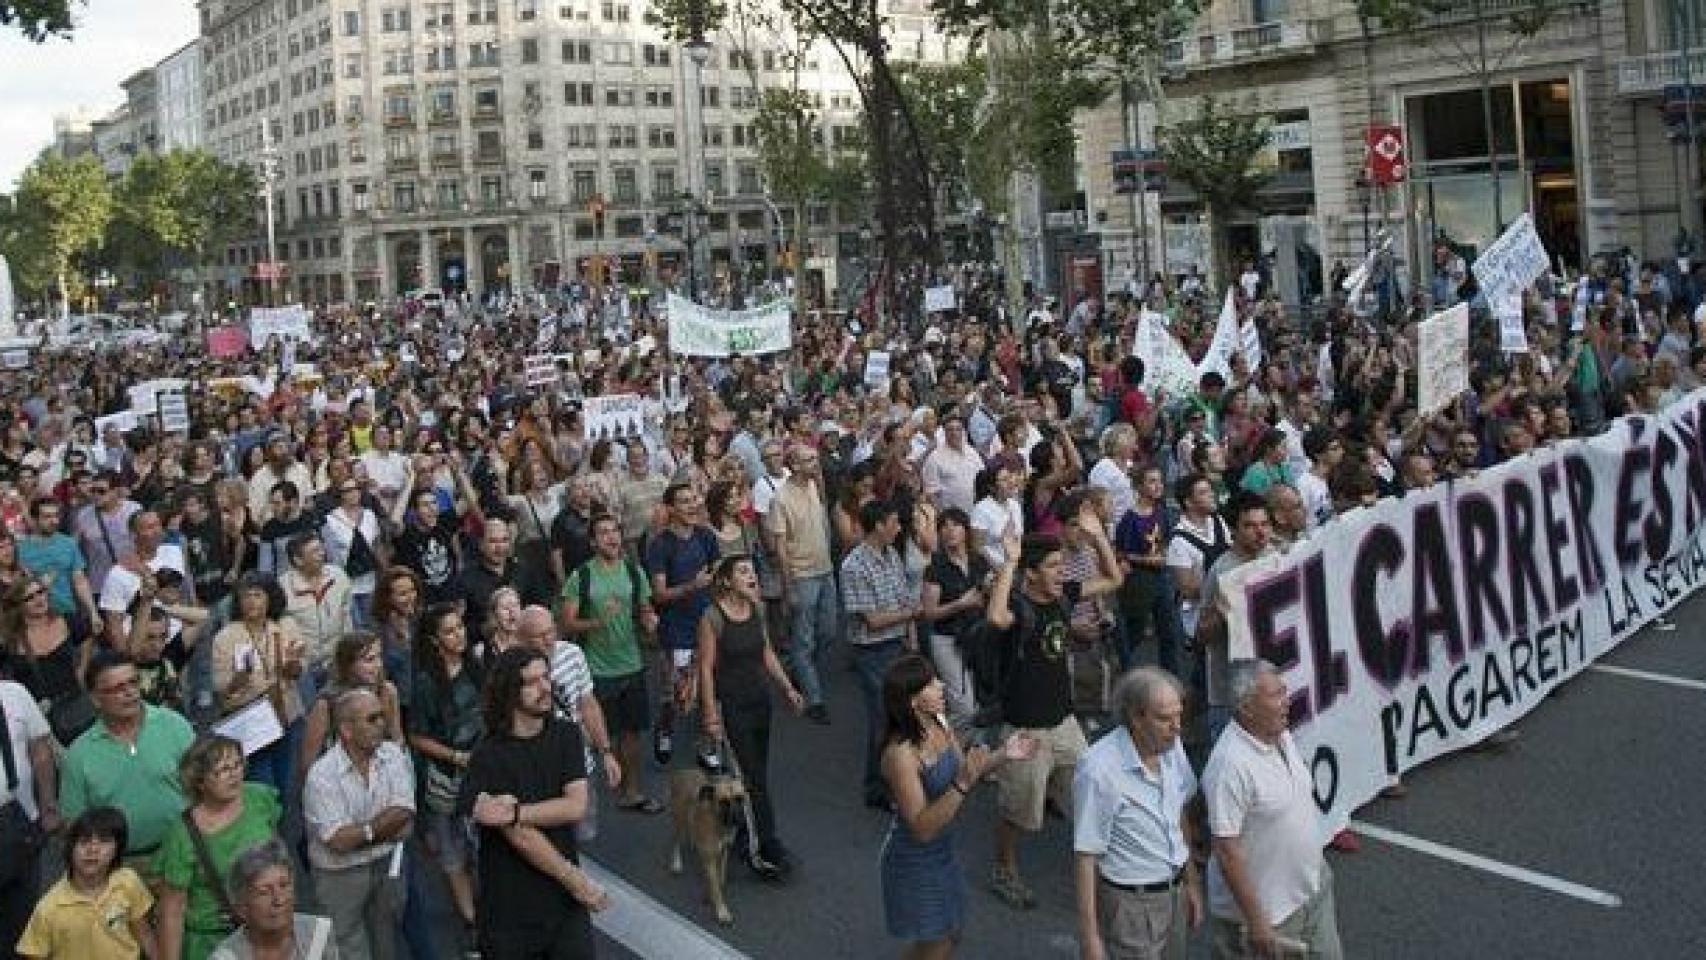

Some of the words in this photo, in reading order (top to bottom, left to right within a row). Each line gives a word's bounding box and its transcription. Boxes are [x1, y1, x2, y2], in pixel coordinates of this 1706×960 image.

[1246, 551, 1350, 728] EL
[1350, 453, 1606, 690] CARRER
[1614, 418, 1678, 564] ÉS
[1310, 746, 1339, 814] O
[1381, 610, 1585, 775] PAGAREM
[1605, 564, 1640, 636] LA
